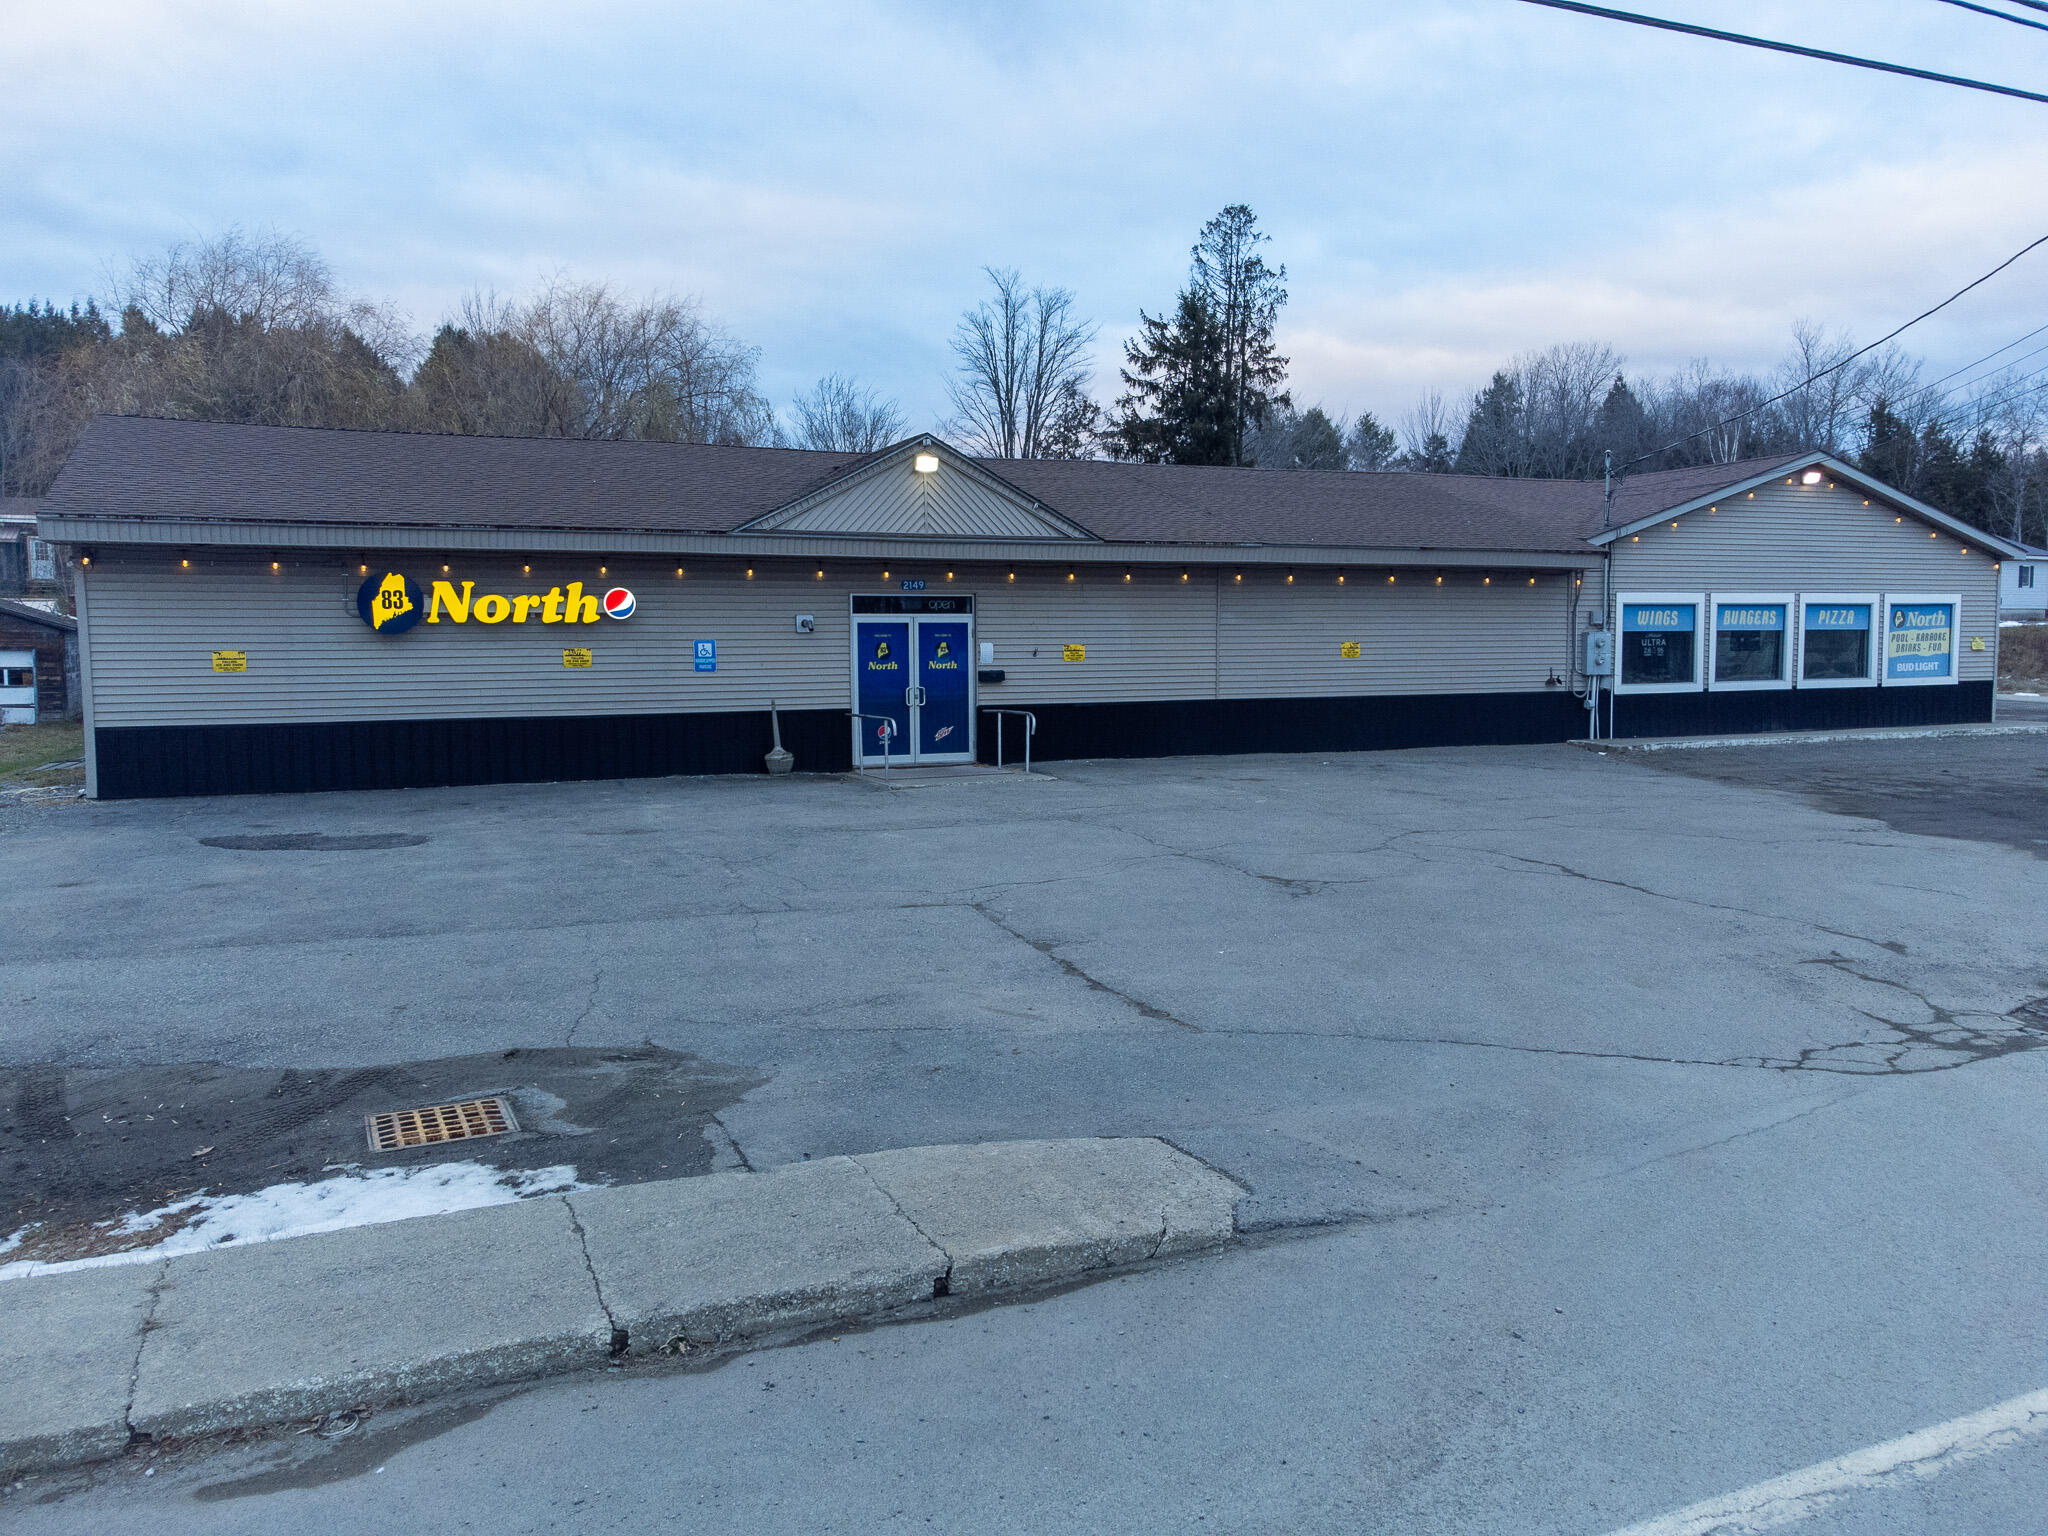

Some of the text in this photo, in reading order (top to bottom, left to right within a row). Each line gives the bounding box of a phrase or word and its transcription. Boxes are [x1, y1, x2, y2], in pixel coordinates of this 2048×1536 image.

[903, 581, 925, 590] 2149
[381, 581, 601, 624] 83 North
[928, 600, 955, 611] open
[1637, 610, 1679, 626] WINGS
[1723, 610, 1777, 625] BURGERS
[1818, 610, 1855, 625] PIZZA
[1906, 610, 1945, 626] North
[1641, 638, 1666, 647] ULTRA
[1891, 633, 1909, 643] POOL
[1916, 632, 1947, 641] KARAOKE
[1896, 643, 1921, 653] DRINKS
[1928, 642, 1942, 652] FUN
[868, 661, 898, 670] North
[928, 661, 957, 669] North
[1896, 662, 1939, 672] BUD LIGHT
